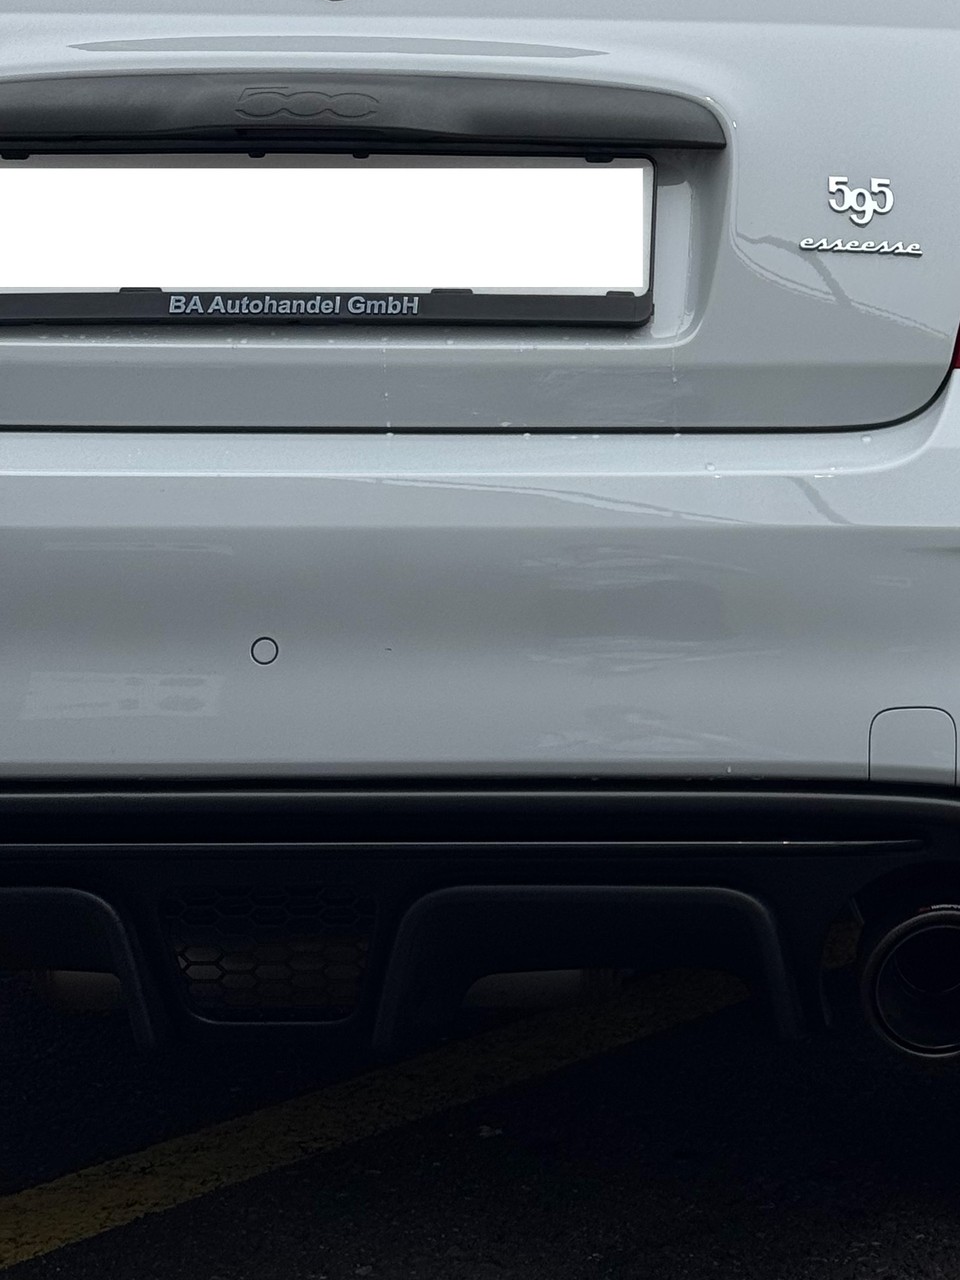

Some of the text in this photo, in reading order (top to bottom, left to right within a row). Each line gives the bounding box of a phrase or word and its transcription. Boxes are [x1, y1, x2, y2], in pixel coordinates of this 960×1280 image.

[234, 86, 380, 120] 500
[827, 175, 894, 228] 595
[799, 237, 923, 258] esseesse
[168, 295, 419, 314] BA Autohandel GmbH
